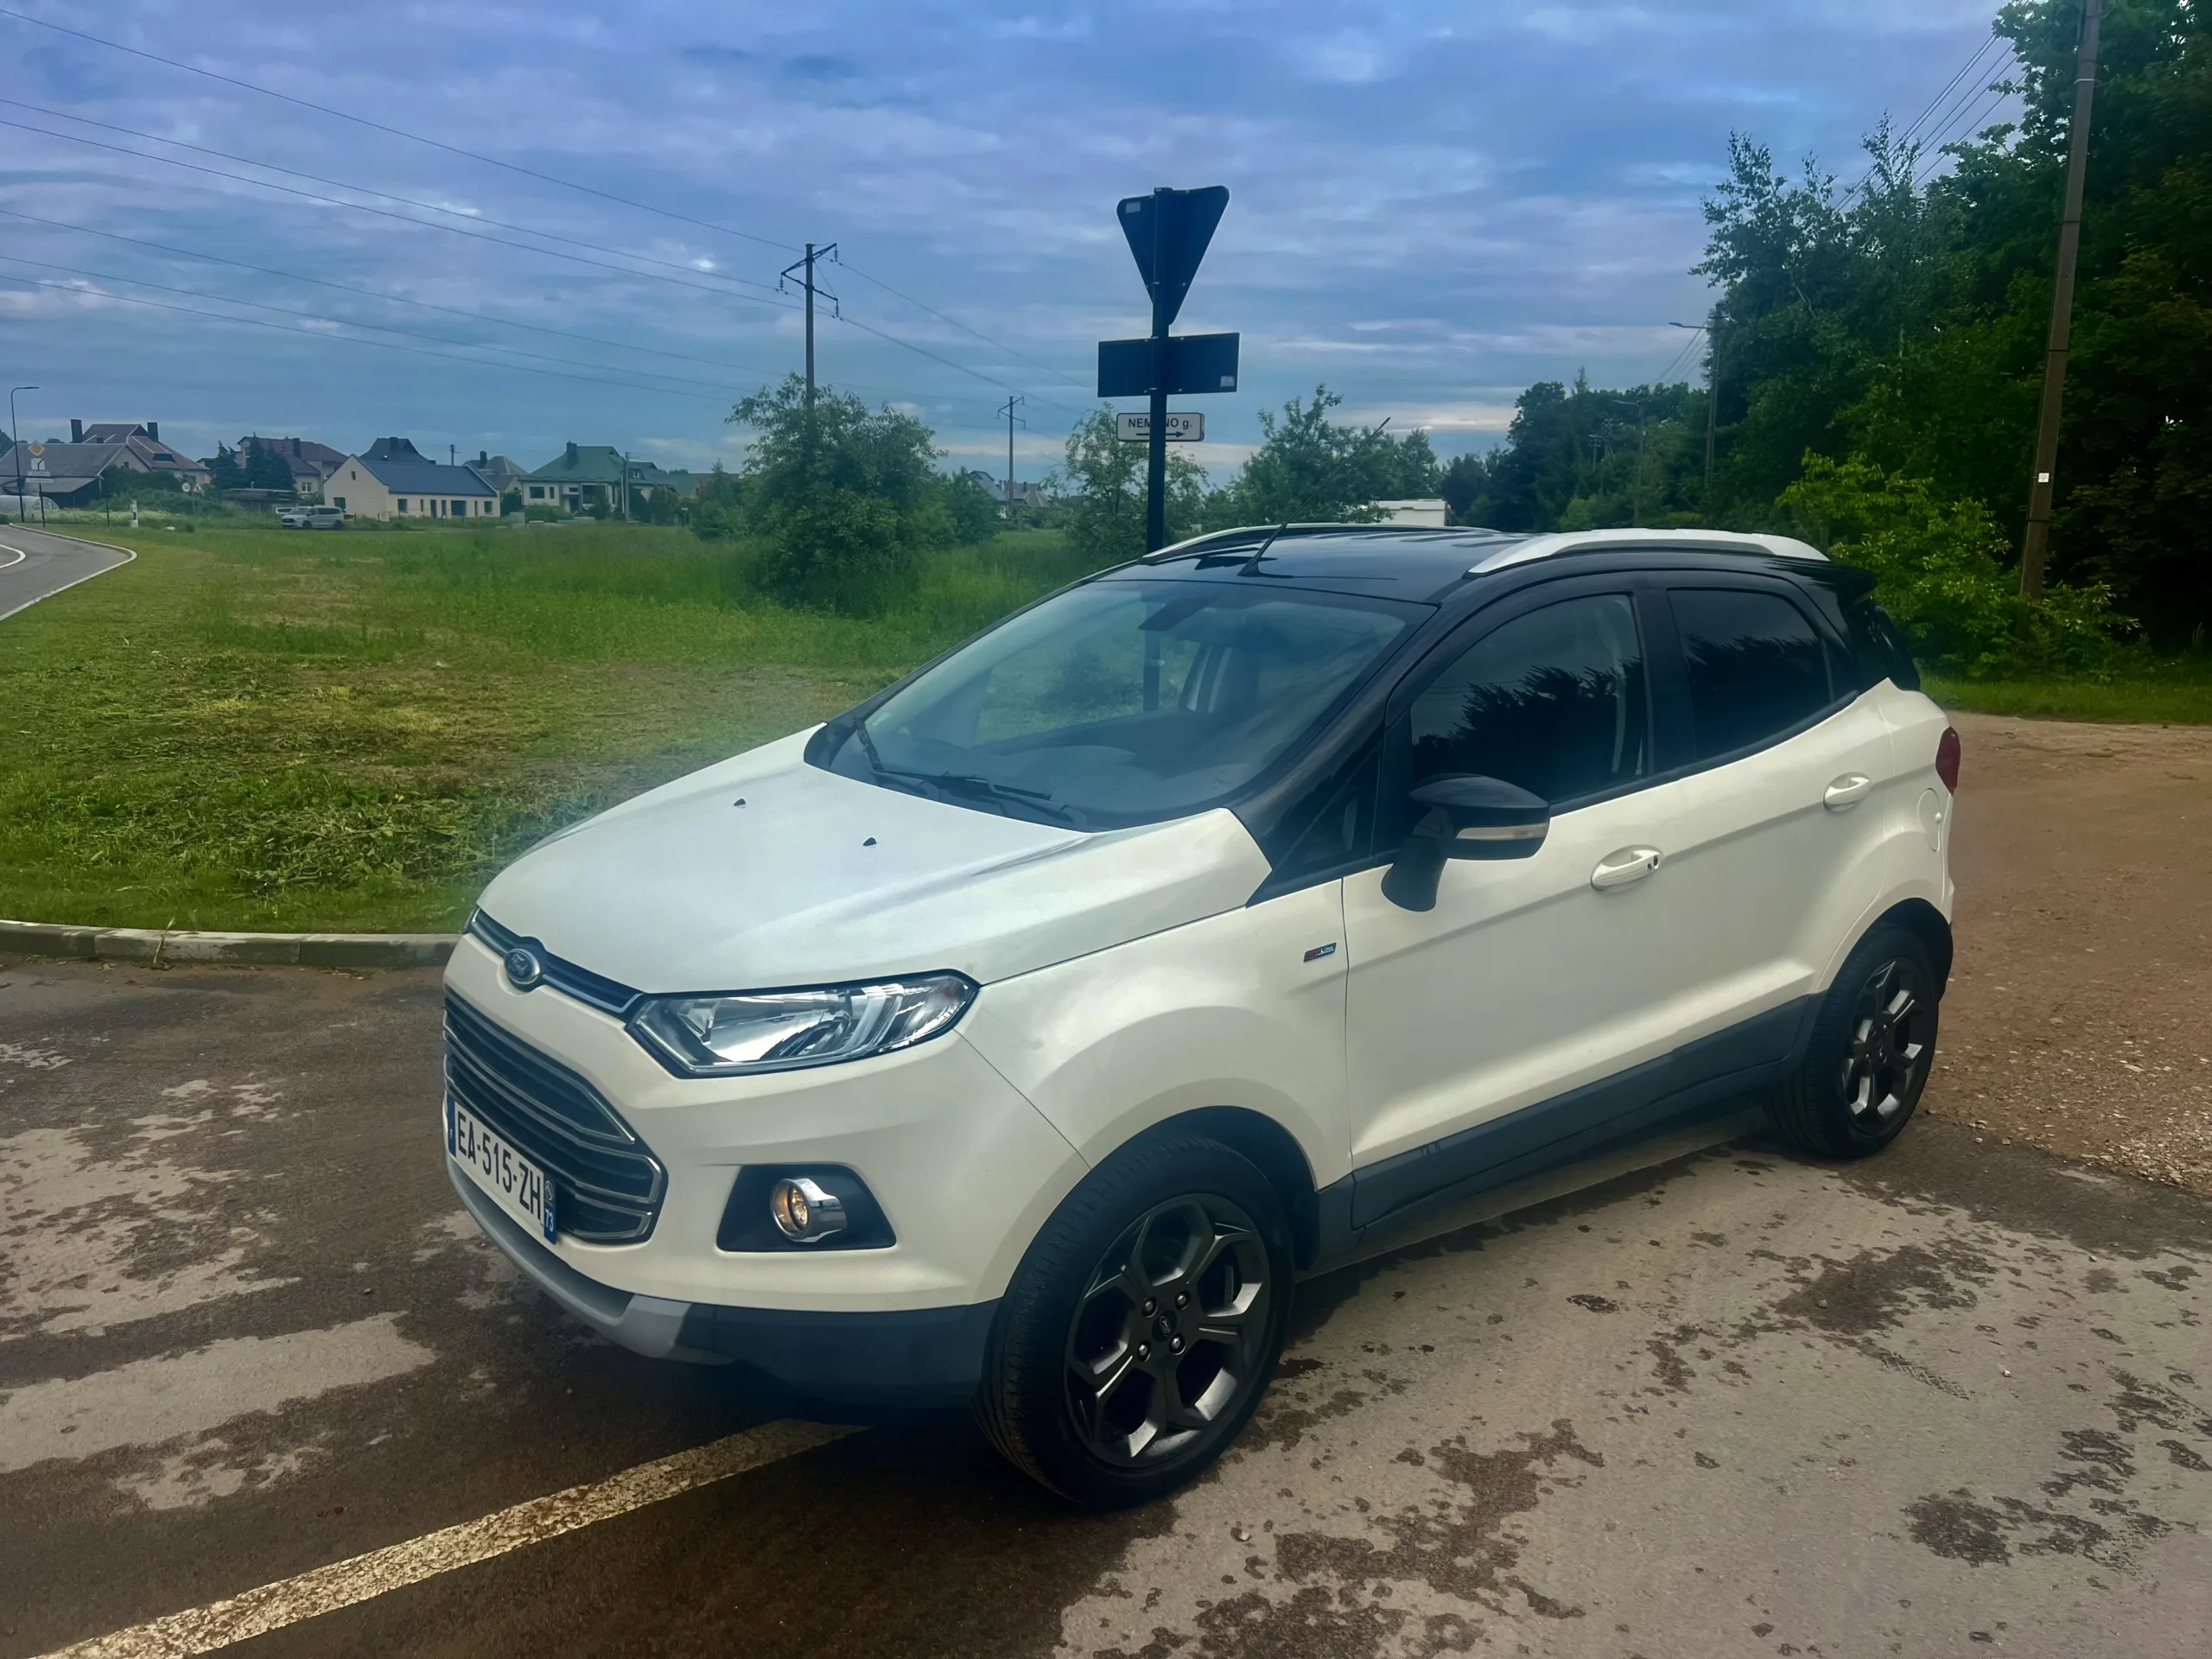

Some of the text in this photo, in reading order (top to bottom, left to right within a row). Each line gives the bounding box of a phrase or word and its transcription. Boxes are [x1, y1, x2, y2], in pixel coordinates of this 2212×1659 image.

[1182, 420, 1192, 430] g.
[457, 1110, 541, 1220] EA-515-ZH
[544, 1208, 554, 1232] 73
